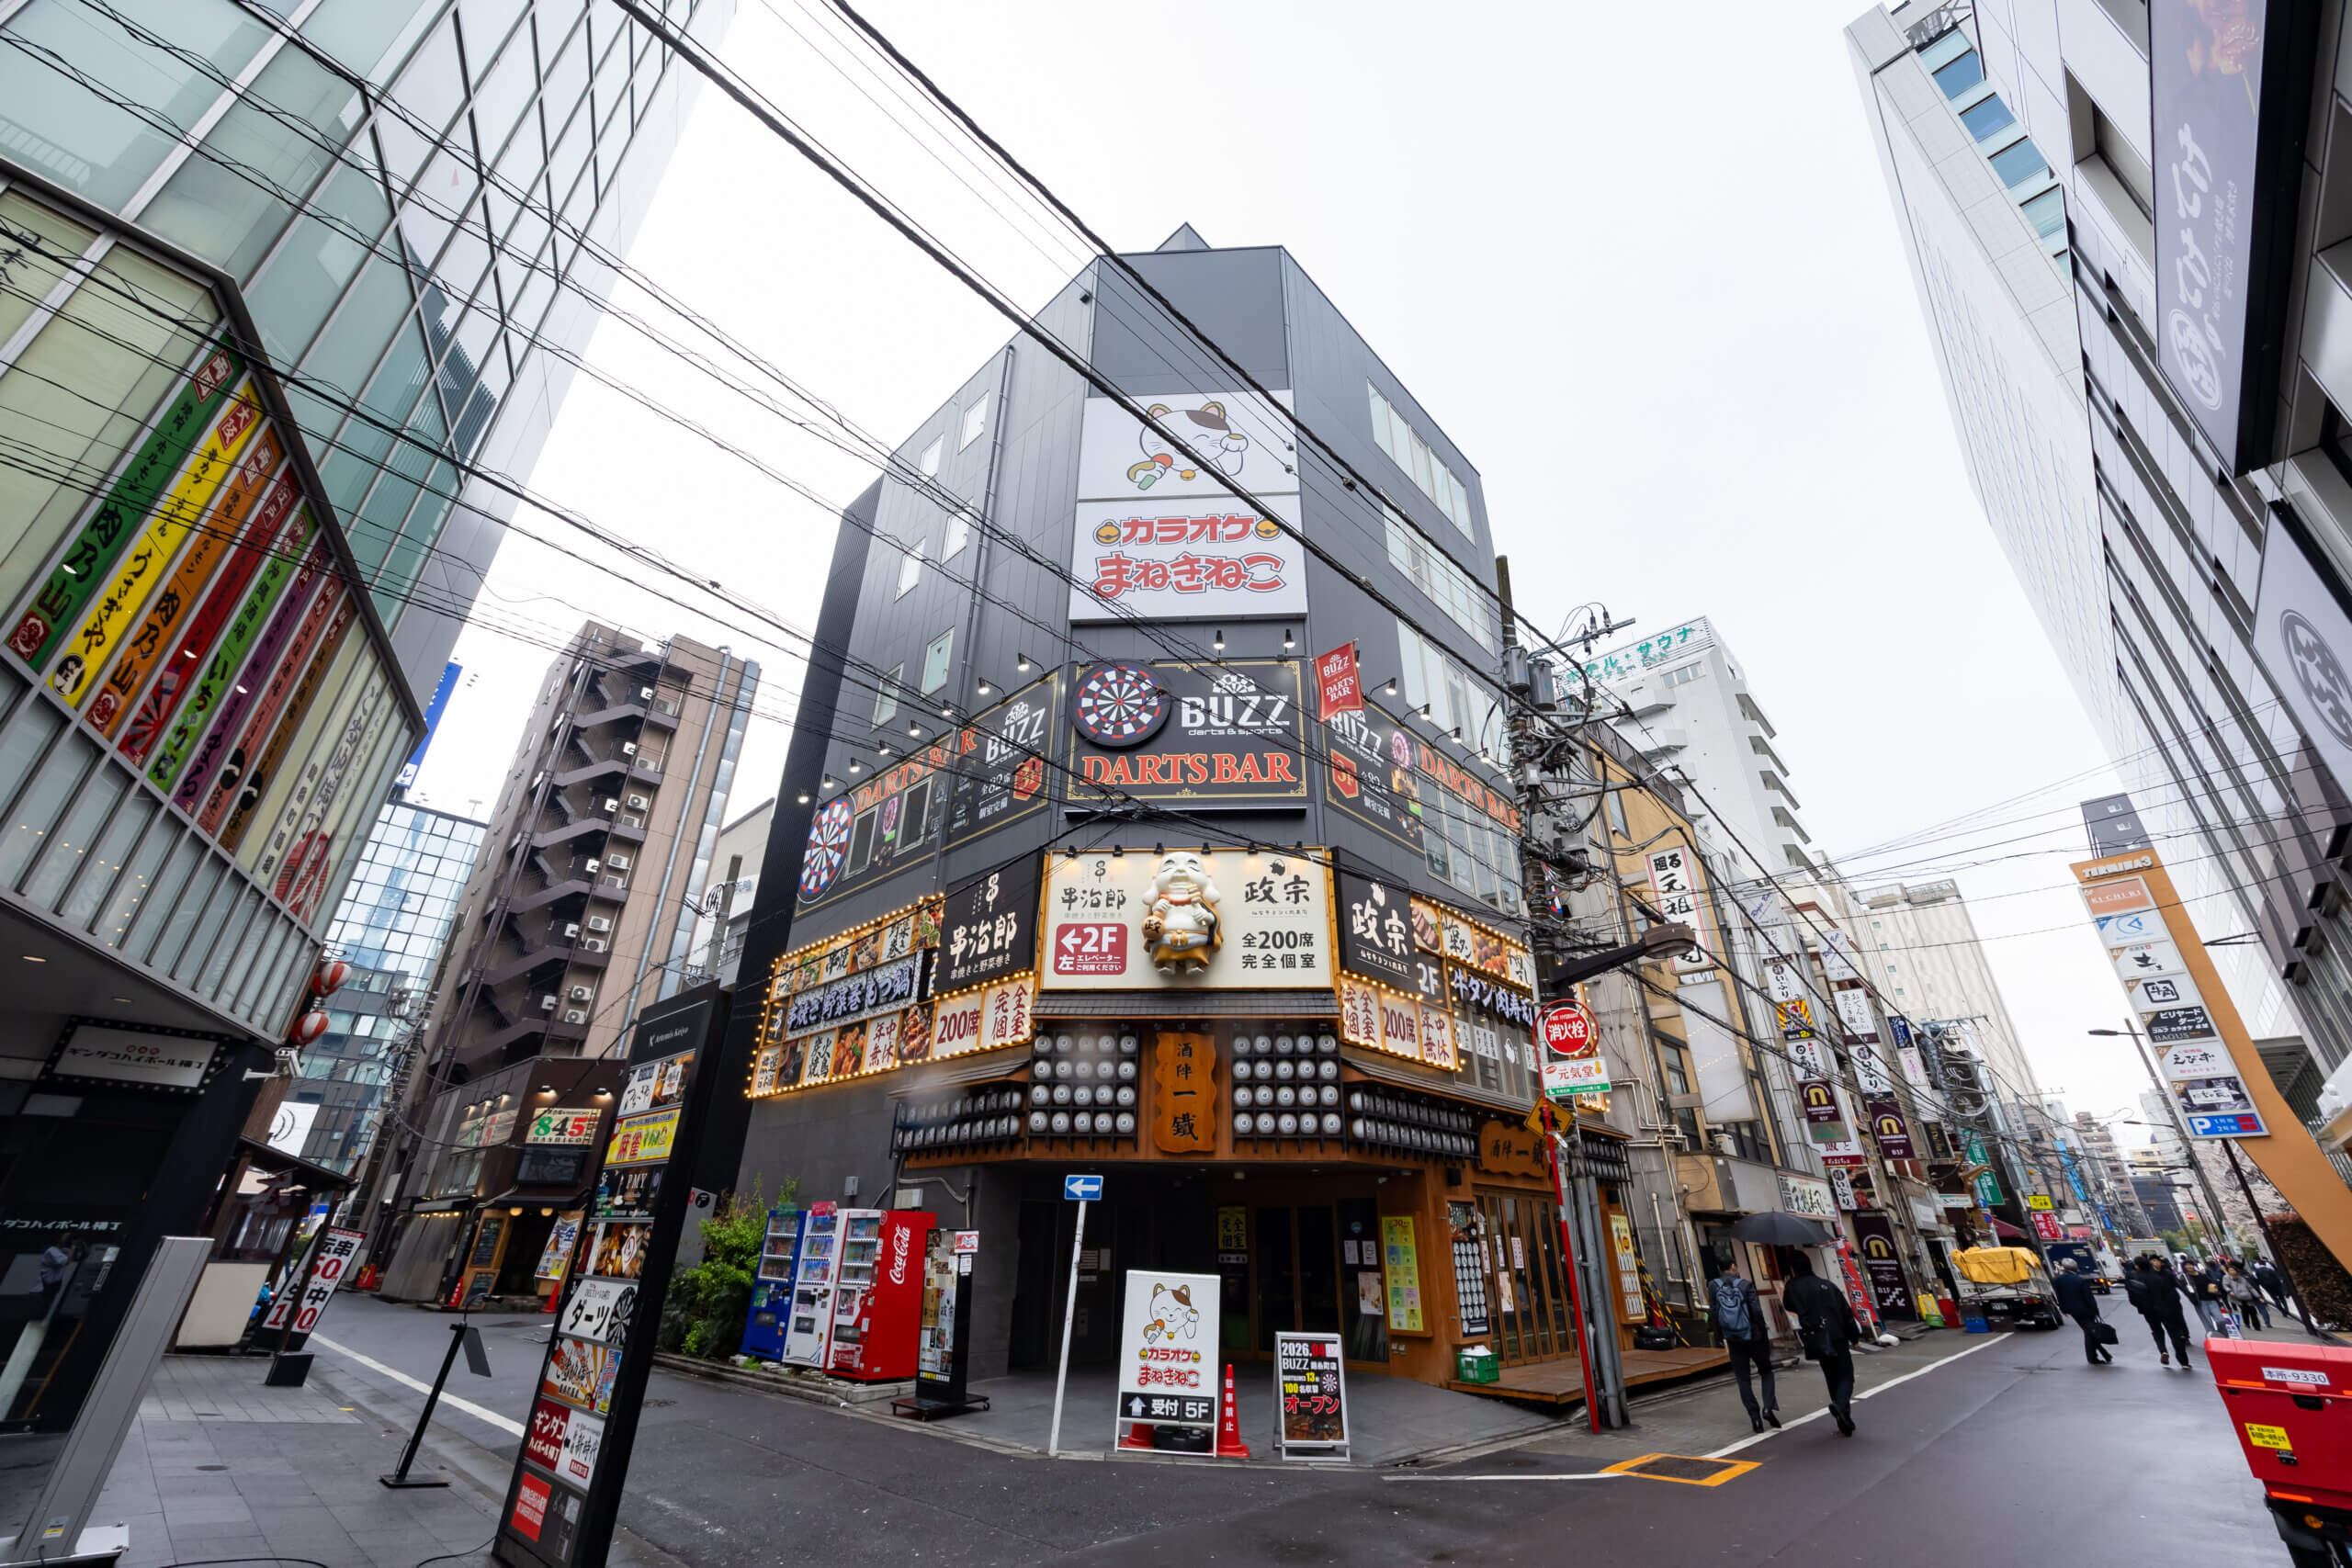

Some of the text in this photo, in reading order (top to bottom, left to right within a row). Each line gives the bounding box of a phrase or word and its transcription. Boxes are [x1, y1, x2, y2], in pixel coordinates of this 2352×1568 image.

[219, 398, 256, 448] 大阪
[1121, 514, 1257, 545] カラオケ
[1091, 552, 1286, 599] まねきねこ
[1323, 655, 1351, 677] BUZZ
[1326, 676, 1355, 695] DARTS
[1329, 686, 1351, 702] BAR
[1182, 695, 1291, 728] BUZZ
[985, 707, 1046, 764] BUZZ
[1238, 728, 1283, 736] sports
[1330, 711, 1385, 763] BUZZ
[1080, 752, 1297, 786] DARTS BAR
[1419, 744, 1485, 814] DARTS
[854, 761, 923, 814] DARTS
[1061, 887, 1127, 911] 串治郎
[1244, 874, 1310, 904] 政宗
[950, 911, 1018, 967] 串治郎
[1081, 926, 1118, 953] 2F
[1241, 930, 1314, 950] 全200席
[1351, 899, 1408, 957] 政宗
[1057, 954, 1075, 971] 左
[1076, 964, 1123, 972] ご利用ください
[1241, 953, 1316, 970] 完全個室
[1417, 962, 1439, 996] 2F
[1383, 1006, 1417, 1044] 200席
[2160, 1009, 2201, 1019] ビリヤード
[2178, 1016, 2204, 1025] ダーツ
[937, 1008, 981, 1045] 200席
[1547, 1021, 1587, 1042] 消火栓
[68, 1047, 206, 1070] ギンダコハイボール横丁
[1557, 1064, 1595, 1081] 元気堂
[533, 1115, 589, 1137] 845
[2191, 1117, 2212, 1135] P
[0, 1218, 123, 1232] ダコハイボール横丁
[888, 1223, 911, 1285] Coca-Cola
[569, 1298, 611, 1337] ダーツ
[1148, 1348, 1193, 1363] カラオケ
[1283, 1358, 1309, 1370] BUZZ
[1137, 1364, 1201, 1389] まねきねこ
[1151, 1399, 1209, 1419] 受付 5F
[1284, 1394, 1340, 1415] オープン
[535, 1409, 567, 1441] ギンダコ
